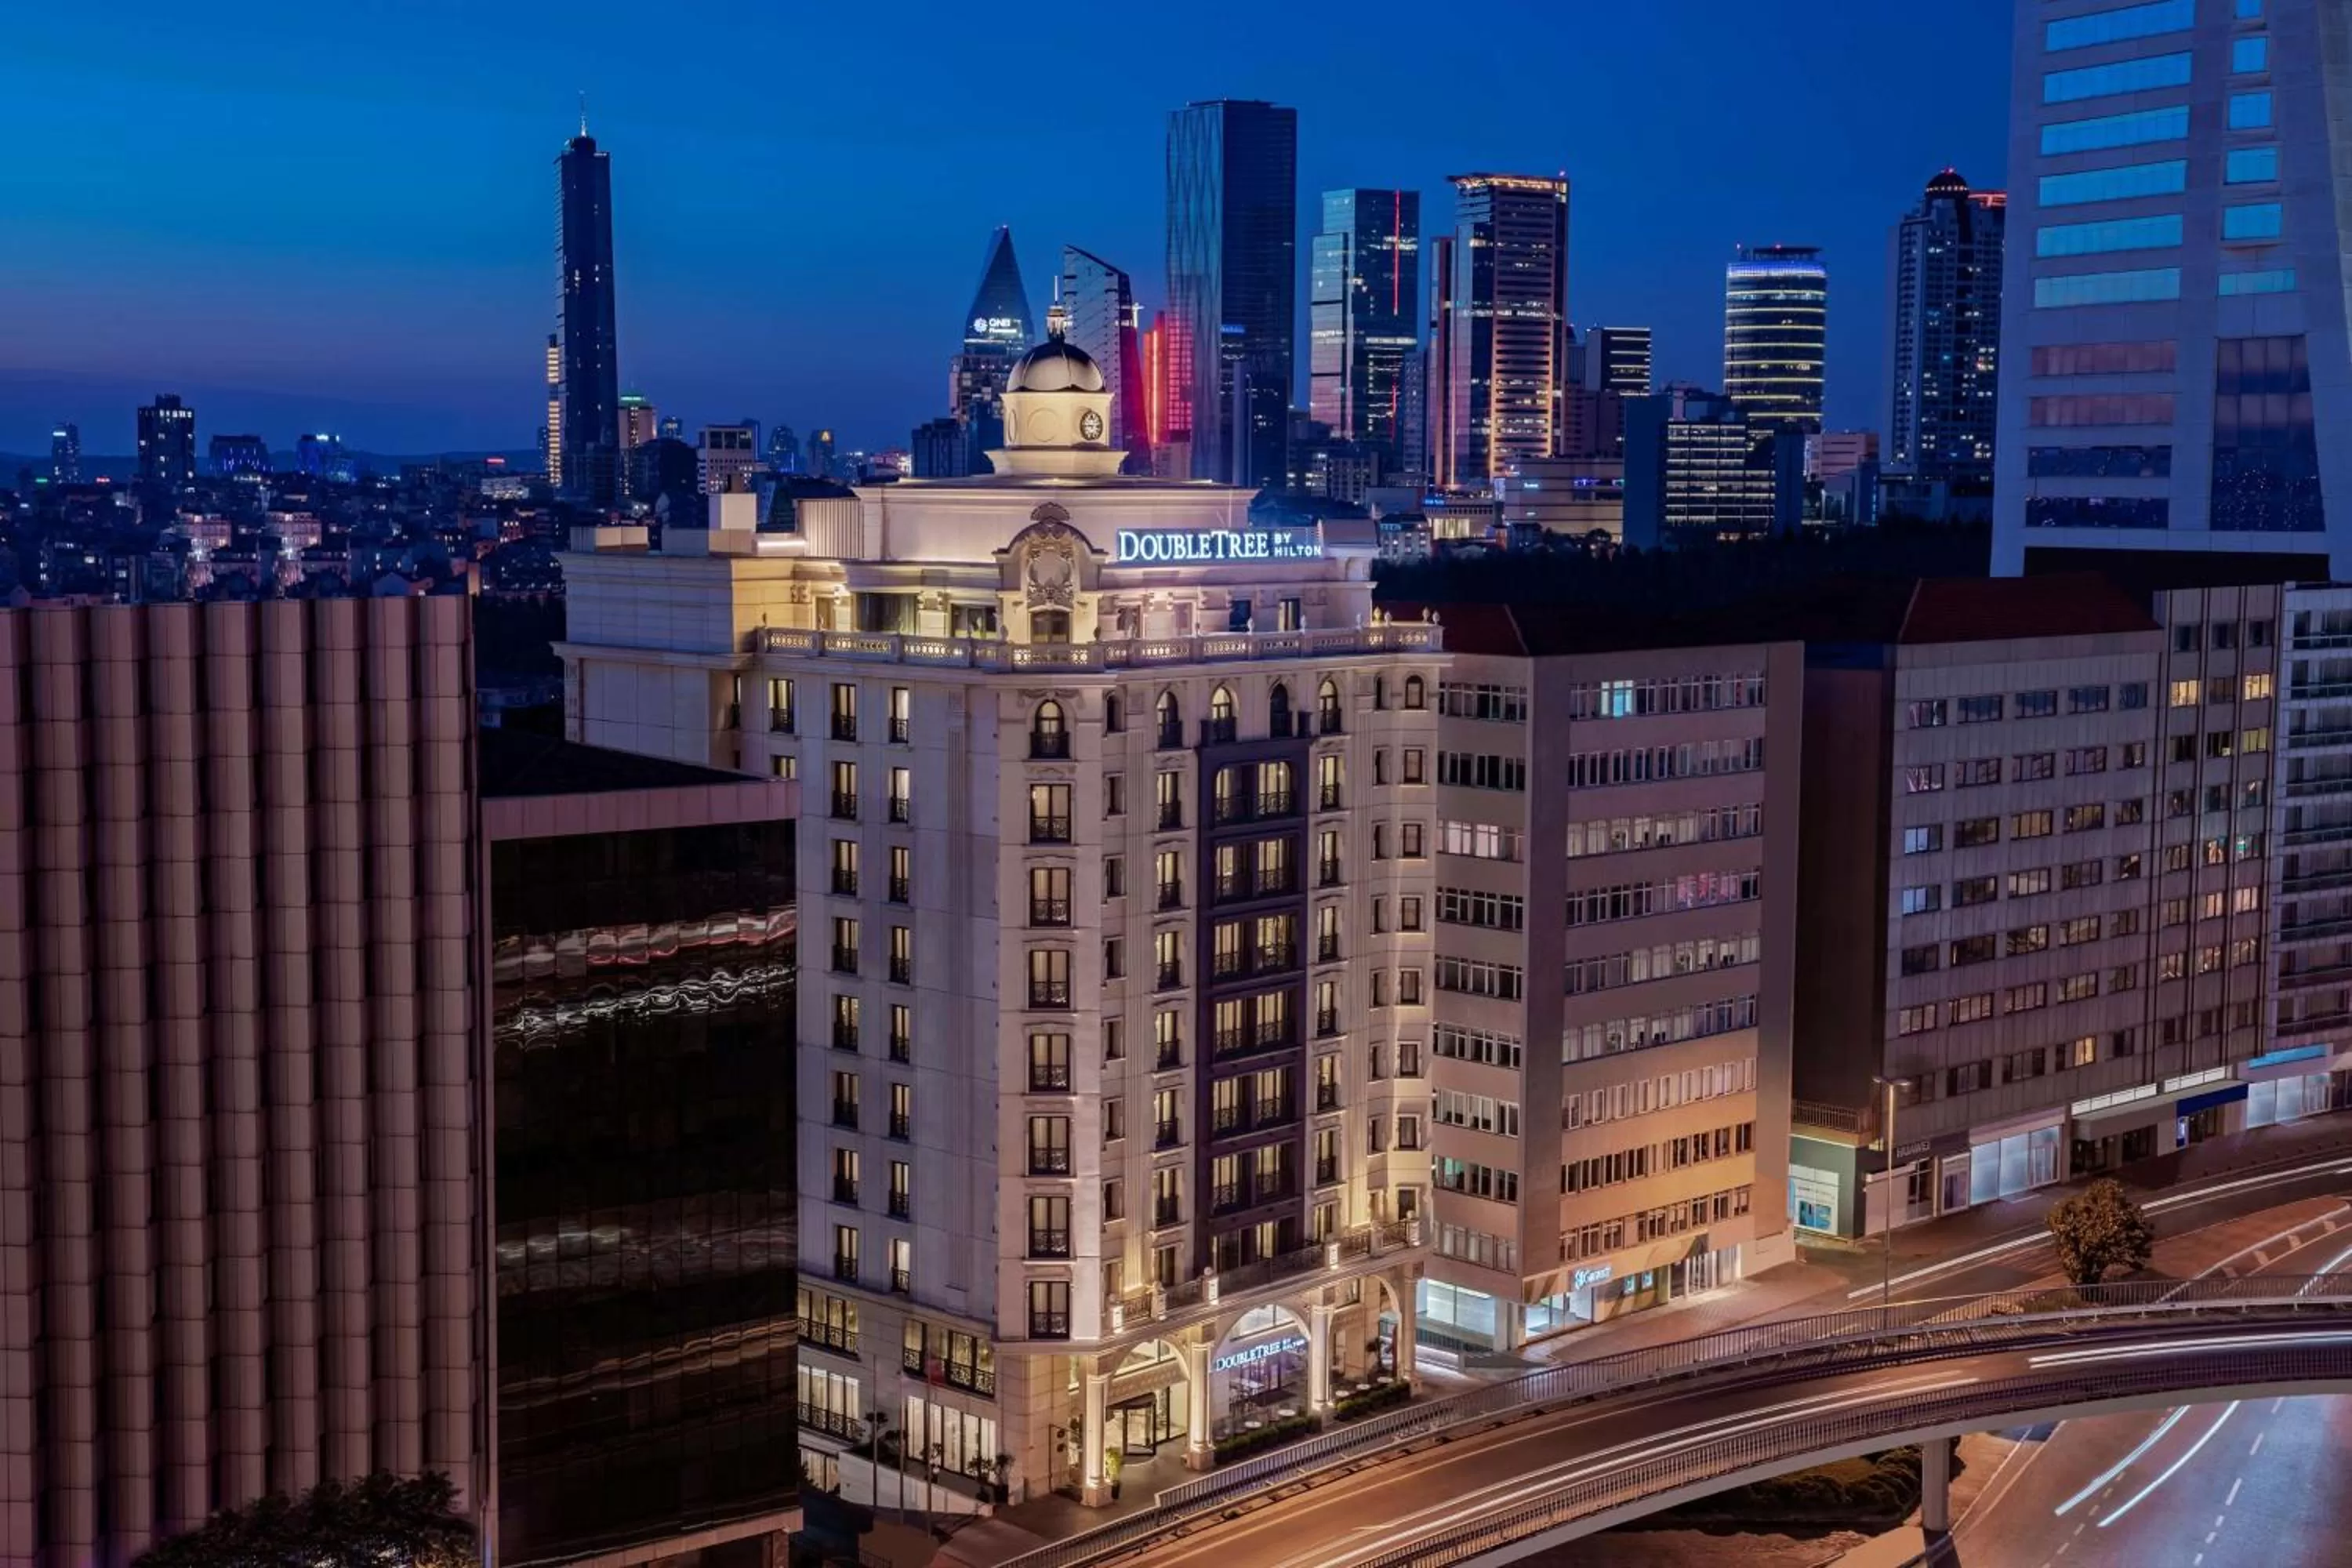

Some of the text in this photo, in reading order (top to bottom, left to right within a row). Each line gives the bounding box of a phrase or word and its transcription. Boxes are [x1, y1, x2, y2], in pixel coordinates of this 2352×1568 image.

[1118, 530, 1321, 561] DOUBLETREE BY HILTON
[1216, 1342, 1281, 1370] DOUBLETREE
